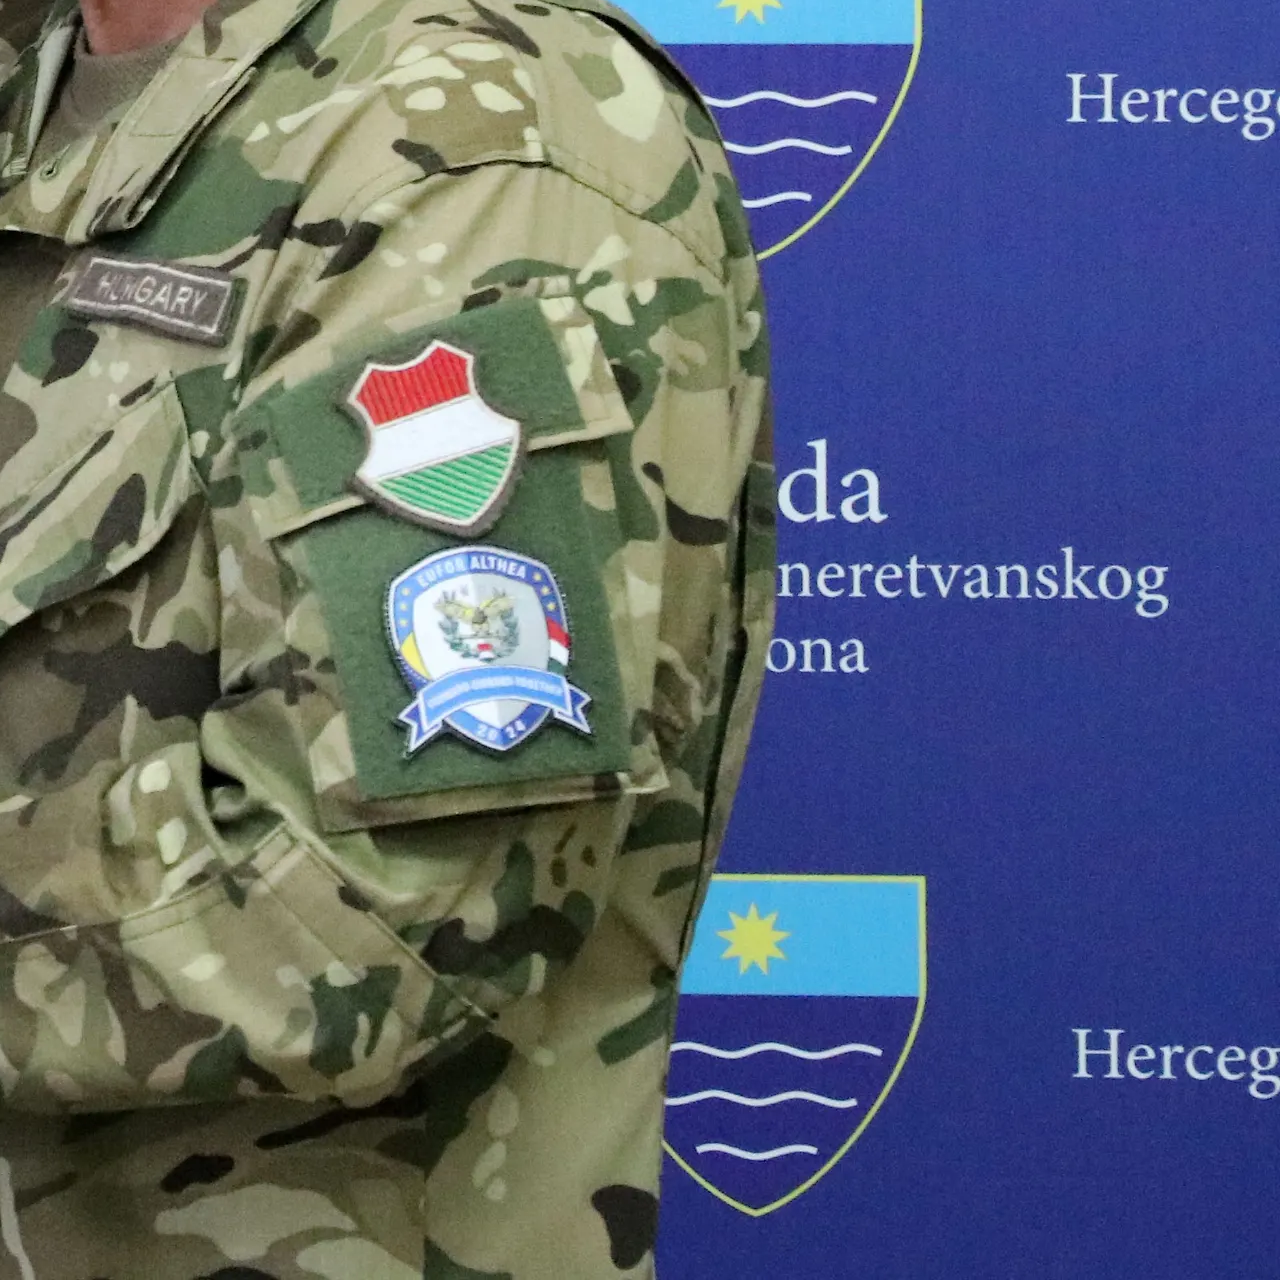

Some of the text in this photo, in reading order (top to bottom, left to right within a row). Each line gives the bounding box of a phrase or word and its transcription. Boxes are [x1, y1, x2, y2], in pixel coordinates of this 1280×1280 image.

[1065, 72, 1280, 141] Herceg
[95, 271, 208, 315] HUNGARY
[416, 555, 527, 587] EUFOR ALTHEA
[777, 546, 1169, 618] neretvanskog
[1072, 1028, 1280, 1100] Herceg
